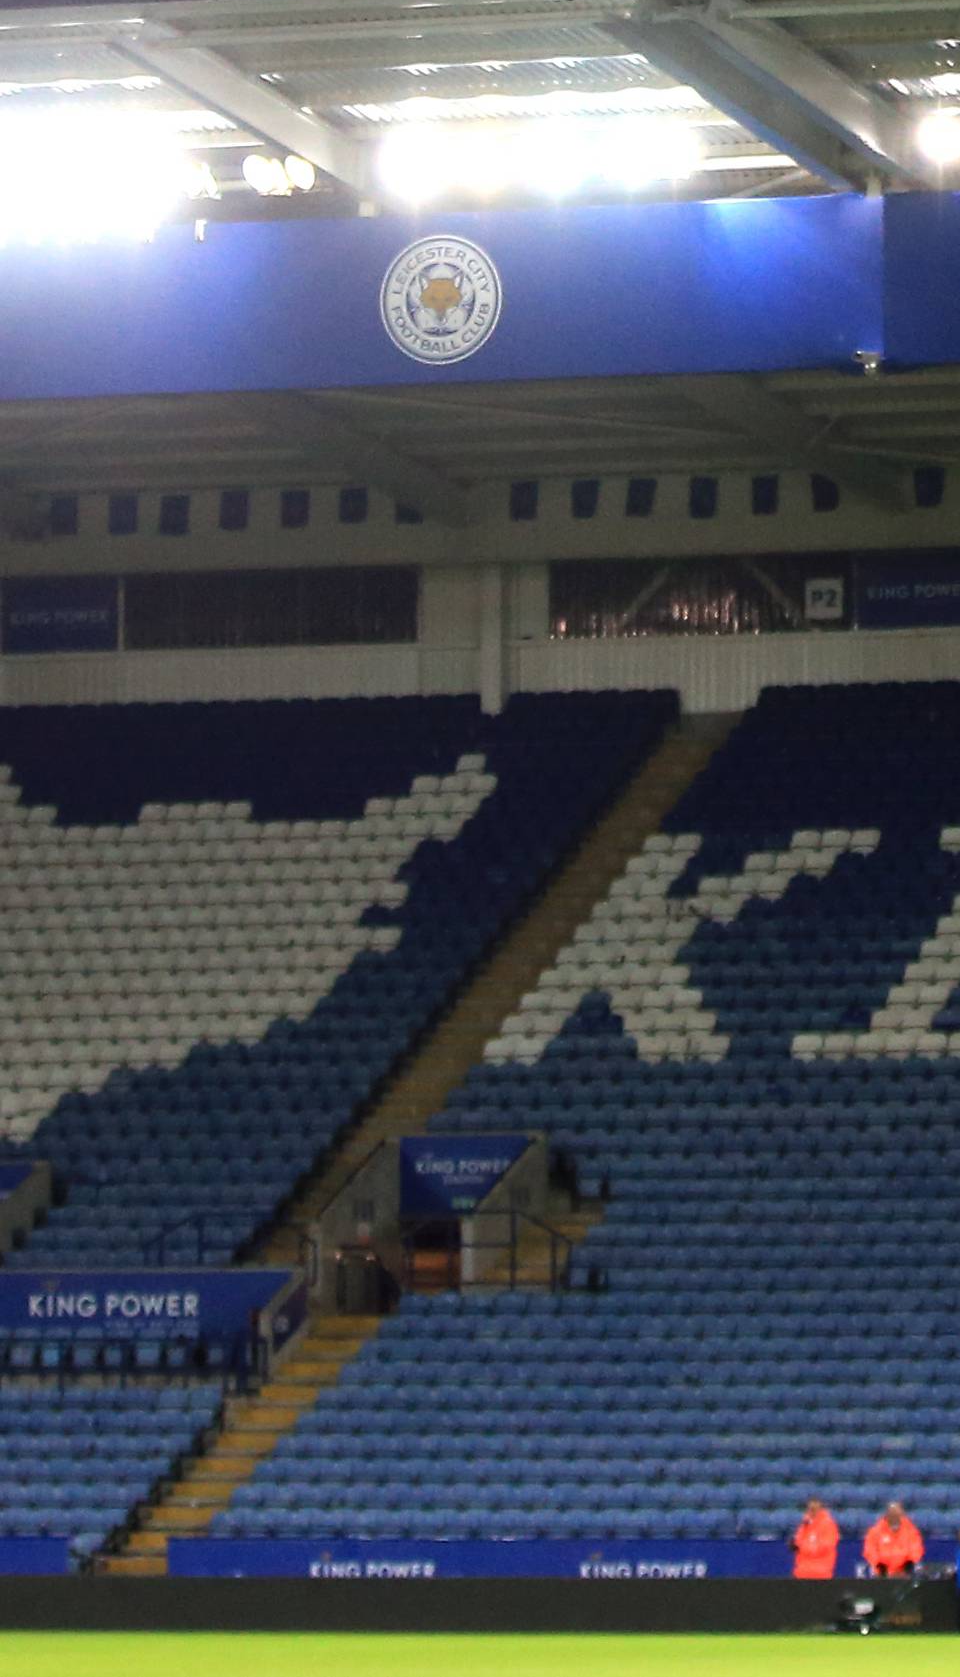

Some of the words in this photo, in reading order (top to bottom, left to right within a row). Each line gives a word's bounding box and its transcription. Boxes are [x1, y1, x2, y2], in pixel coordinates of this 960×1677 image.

[391, 246, 467, 297] LEICESTER
[466, 259, 491, 294] CITY
[391, 305, 461, 353] FOOTBALL
[461, 302, 490, 343] CLUB
[811, 588, 838, 608] P2
[415, 1160, 454, 1174] KING
[28, 1293, 97, 1317] KING
[105, 1292, 200, 1317] POWER
[309, 1561, 362, 1579] KING
[366, 1561, 436, 1579] POWER
[579, 1561, 633, 1579] KING
[637, 1561, 708, 1579] POWER
